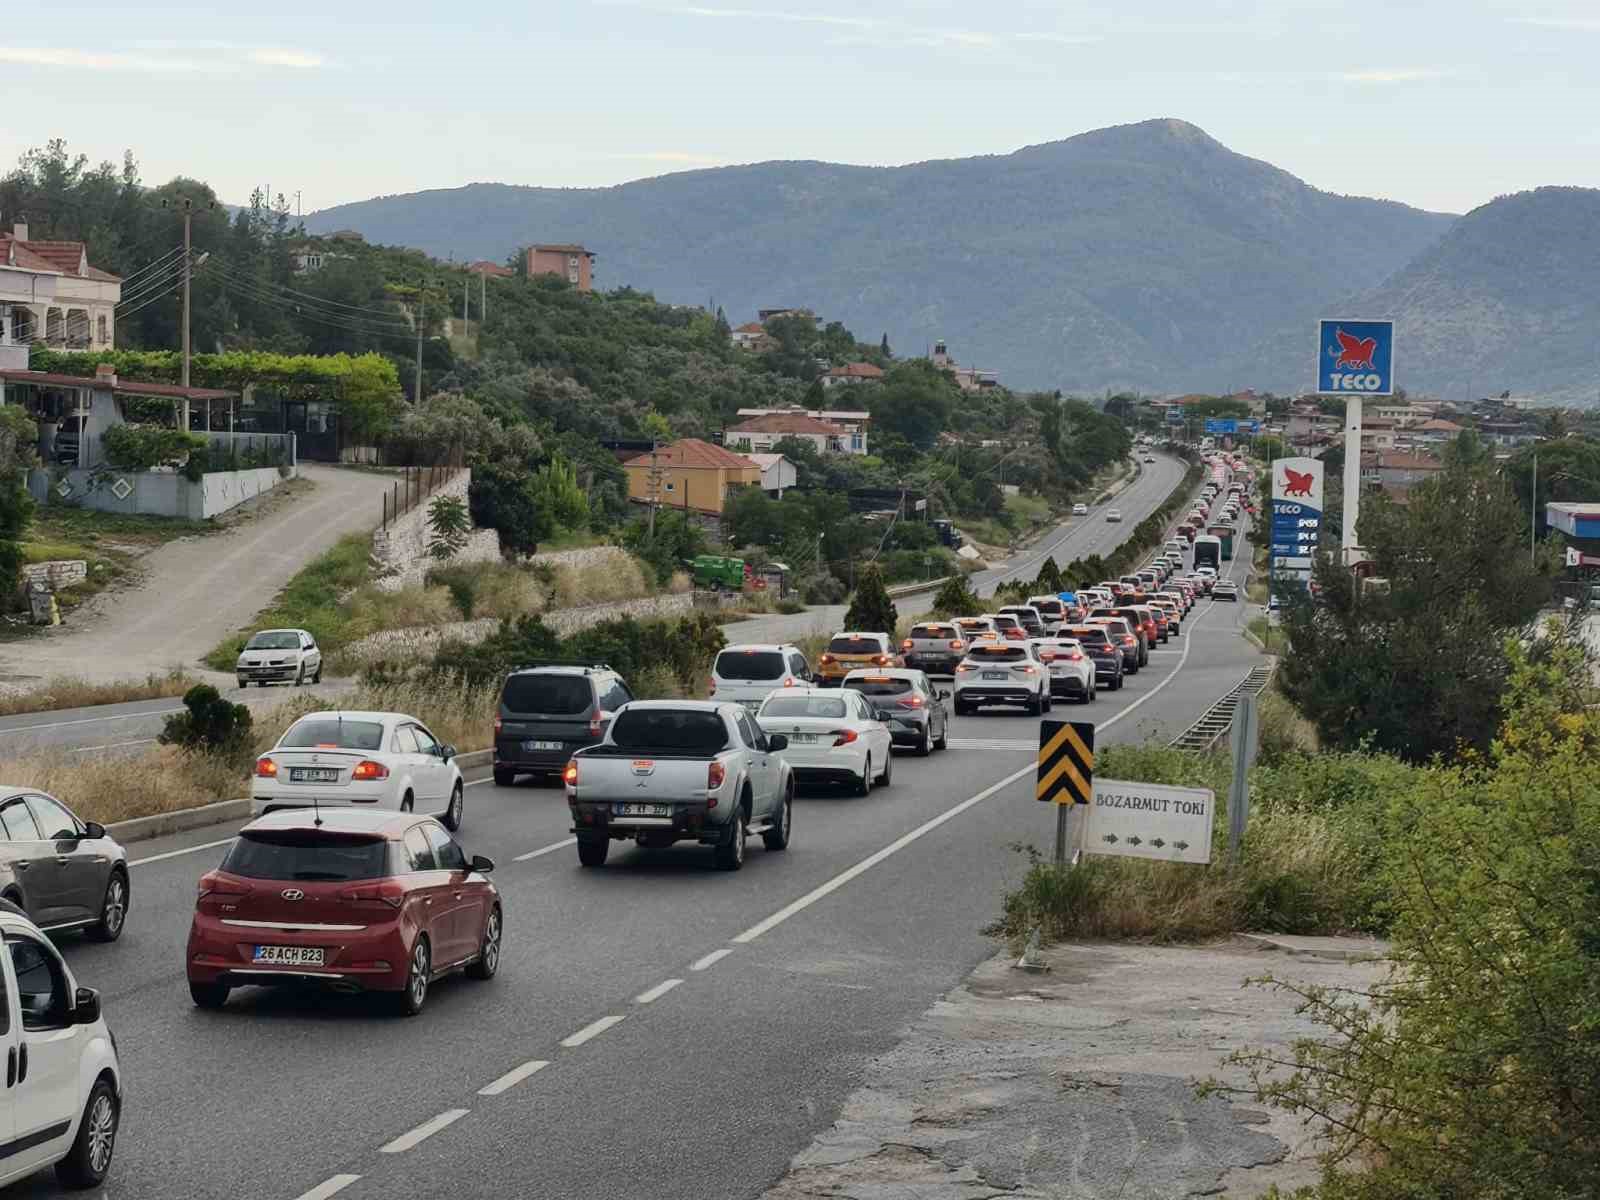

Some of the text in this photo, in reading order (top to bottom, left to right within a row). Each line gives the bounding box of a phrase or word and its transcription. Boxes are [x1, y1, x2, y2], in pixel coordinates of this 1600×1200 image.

[1329, 373, 1381, 391] TECO
[1273, 504, 1301, 514] TECO
[1096, 793, 1170, 812] BOZARMUT
[260, 947, 322, 962] 26 ACH 823
